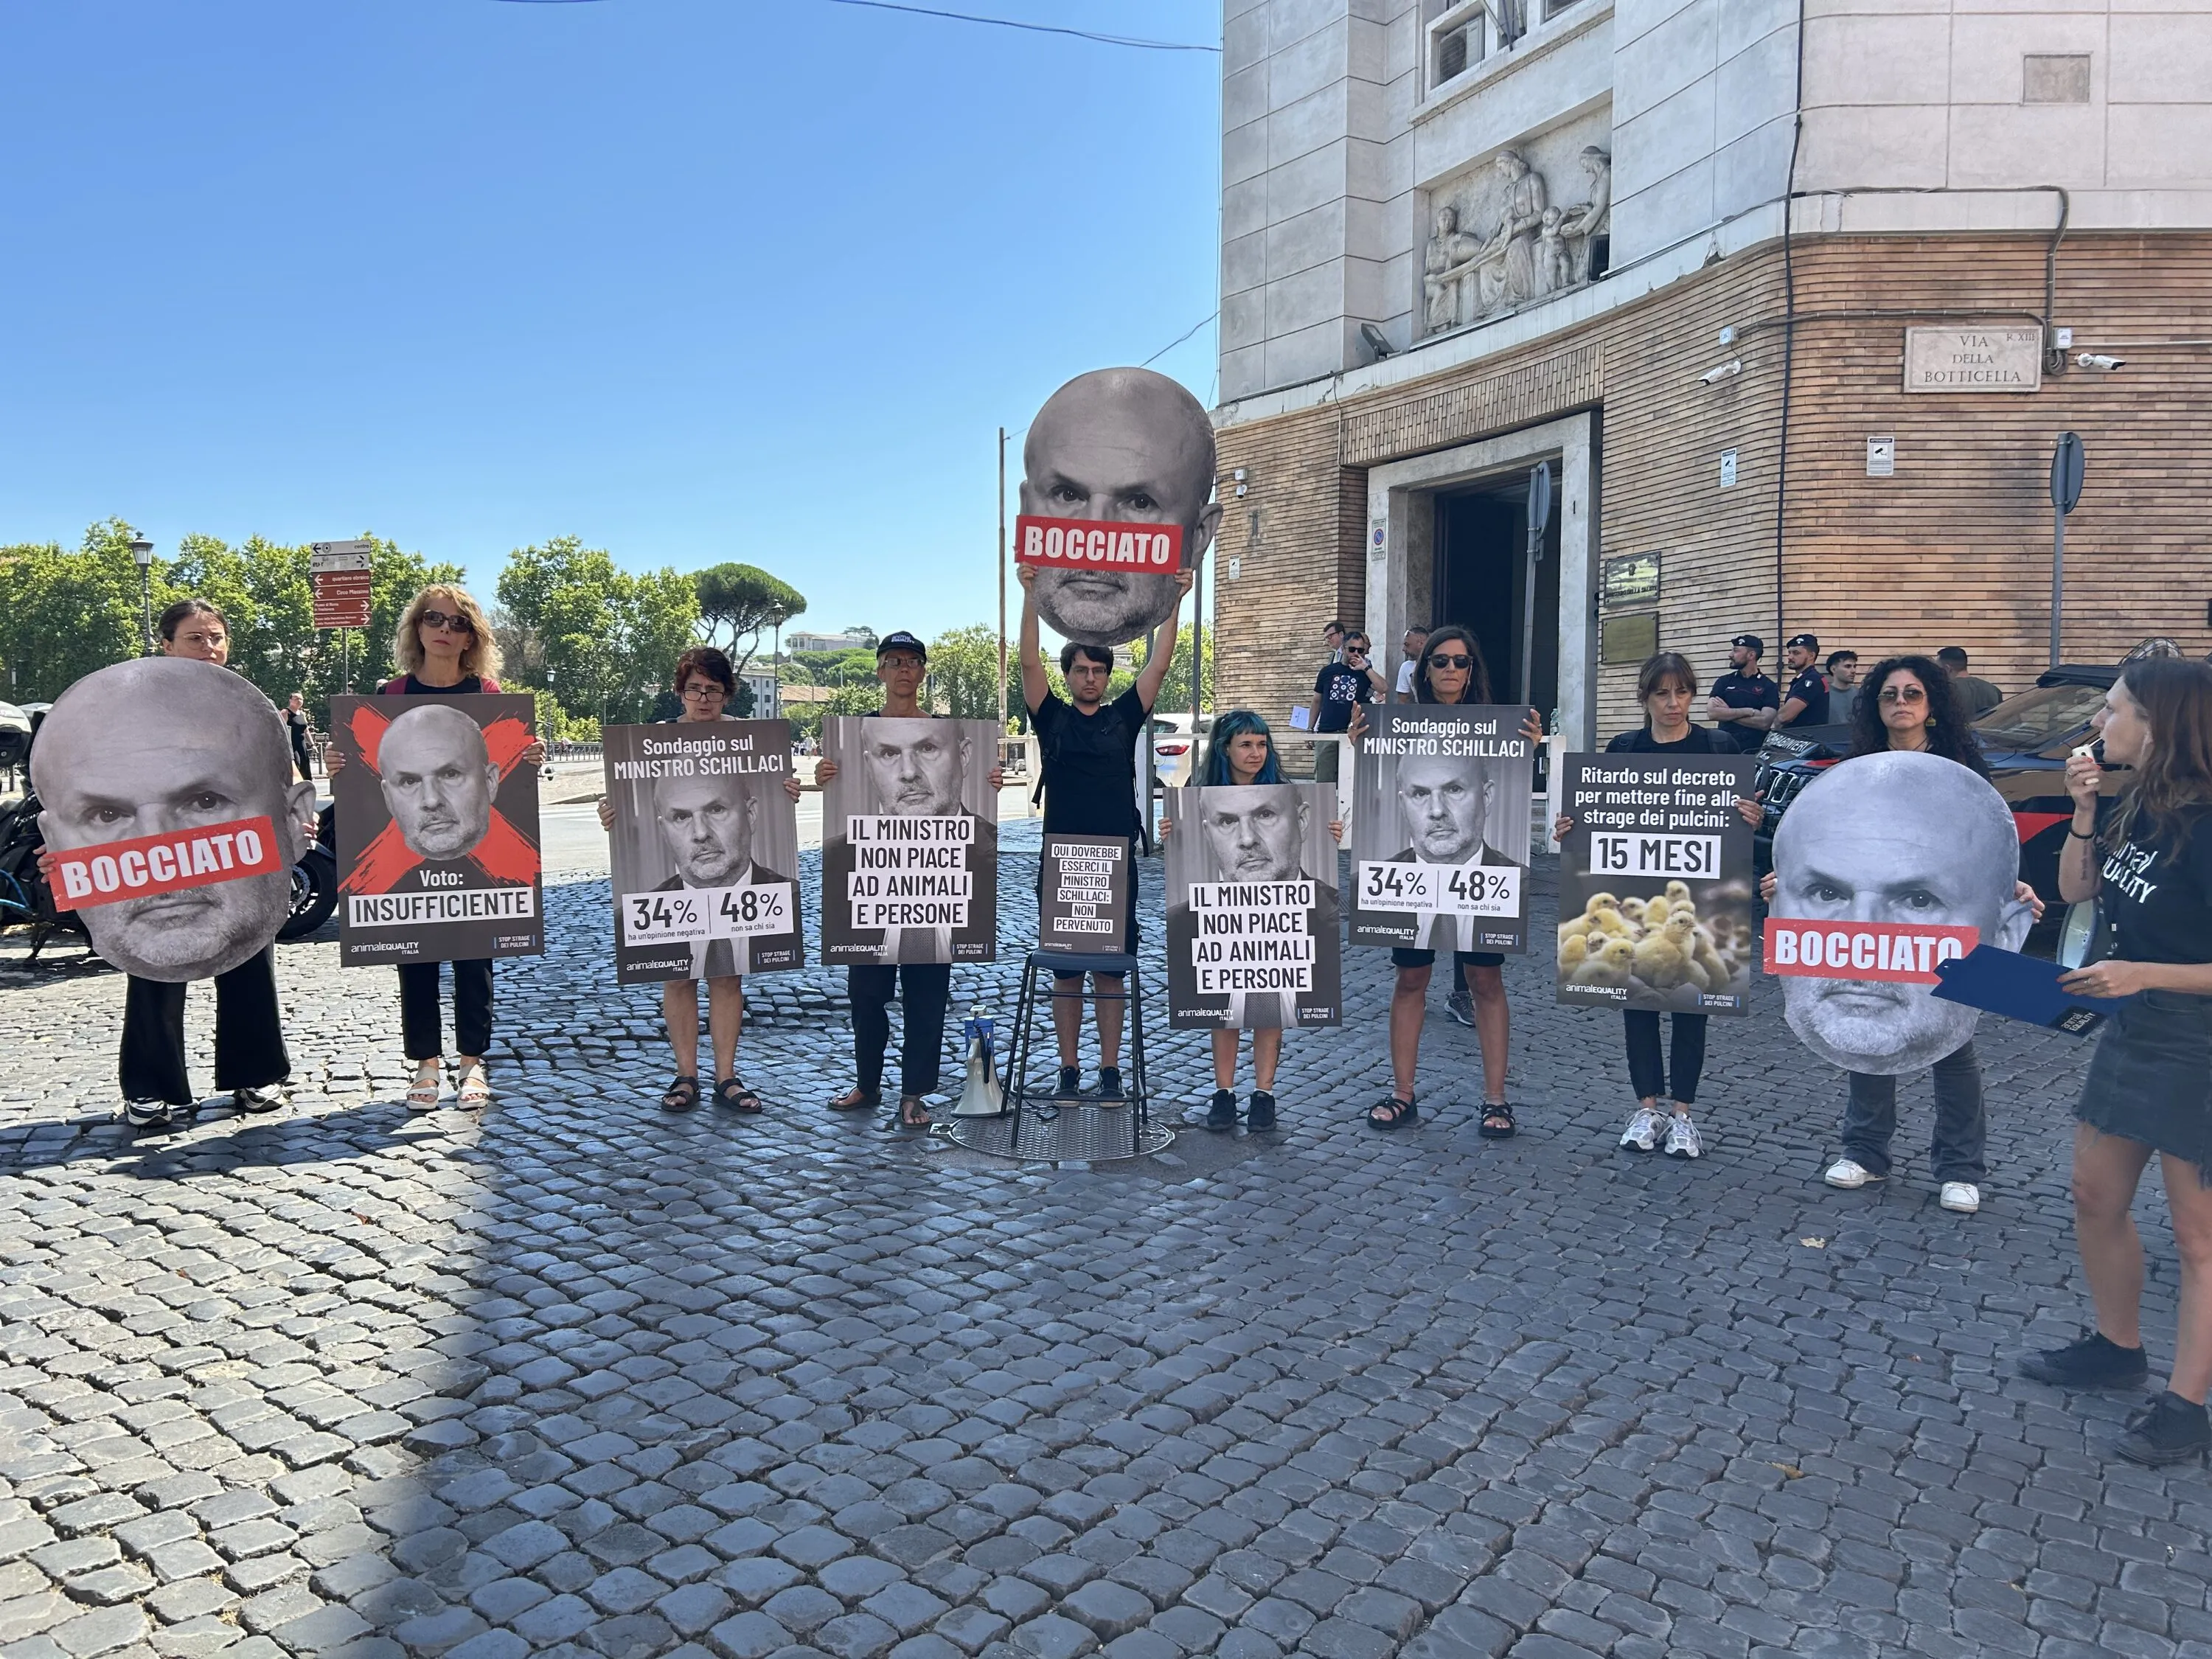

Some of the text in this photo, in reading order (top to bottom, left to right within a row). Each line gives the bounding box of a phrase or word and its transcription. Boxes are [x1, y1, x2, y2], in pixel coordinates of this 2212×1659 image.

[1960, 335, 1989, 347] VIA
[2018, 333, 2035, 341] XIII
[1952, 355, 1994, 364] DELLA
[1924, 371, 2021, 382] BOTTICELLA
[1024, 526, 1170, 565] BOCCIATO
[1391, 717, 1497, 738] Sondaggio sul
[643, 734, 754, 757] Sondaggio sul
[1363, 737, 1525, 757] MINISTRO SCHILLACI
[613, 754, 785, 779] MINISTRO SCHILLACI
[1582, 767, 1736, 786] Ritardo sul decreto
[1575, 790, 1601, 807] per
[1606, 790, 1670, 806] mettere
[1674, 788, 1706, 807] fine
[1584, 809, 1730, 830] strage dei pulcini:
[852, 819, 970, 841] IL MINISTRO
[861, 847, 961, 869] NON PIACE
[1054, 846, 1119, 858] QUI DOVREBBE
[1598, 838, 1711, 873] 15 MESI
[60, 830, 263, 899] BOCCIATO
[1062, 860, 1110, 873] ESSERCI IL
[419, 870, 464, 887] Voto:
[852, 875, 967, 897] AD ANIMALI
[1063, 875, 1107, 887] MINISTRO
[1368, 866, 1510, 901] 34% 48%
[1060, 890, 1110, 902] SCHILLACI:
[1194, 884, 1310, 907] IL MINISTRO
[1370, 898, 1405, 907] un'opinione
[1405, 900, 1433, 909] negativa
[355, 891, 528, 922] INSUFFICIENTE
[633, 890, 783, 931] 34% 48%
[858, 902, 963, 925] E PERSONE
[1074, 905, 1093, 916] NON
[754, 922, 764, 931] chi
[765, 922, 775, 930] sia
[1056, 919, 1110, 931] PERVENUTO
[1203, 912, 1302, 934] NON PIACE
[1357, 925, 1414, 936] animalEQUALITY
[628, 928, 706, 941] ha un'opinione negativa
[351, 941, 420, 953] animalEQUALITY
[830, 943, 888, 953] animalEQUALITY
[1197, 939, 1310, 962] AD ANIMALI
[627, 959, 689, 971] animalEQUALITY
[1202, 967, 1307, 990] E PERSONE
[1565, 983, 1627, 995] animalEQUALITY
[1178, 1008, 1234, 1017] animalEQUALITY
